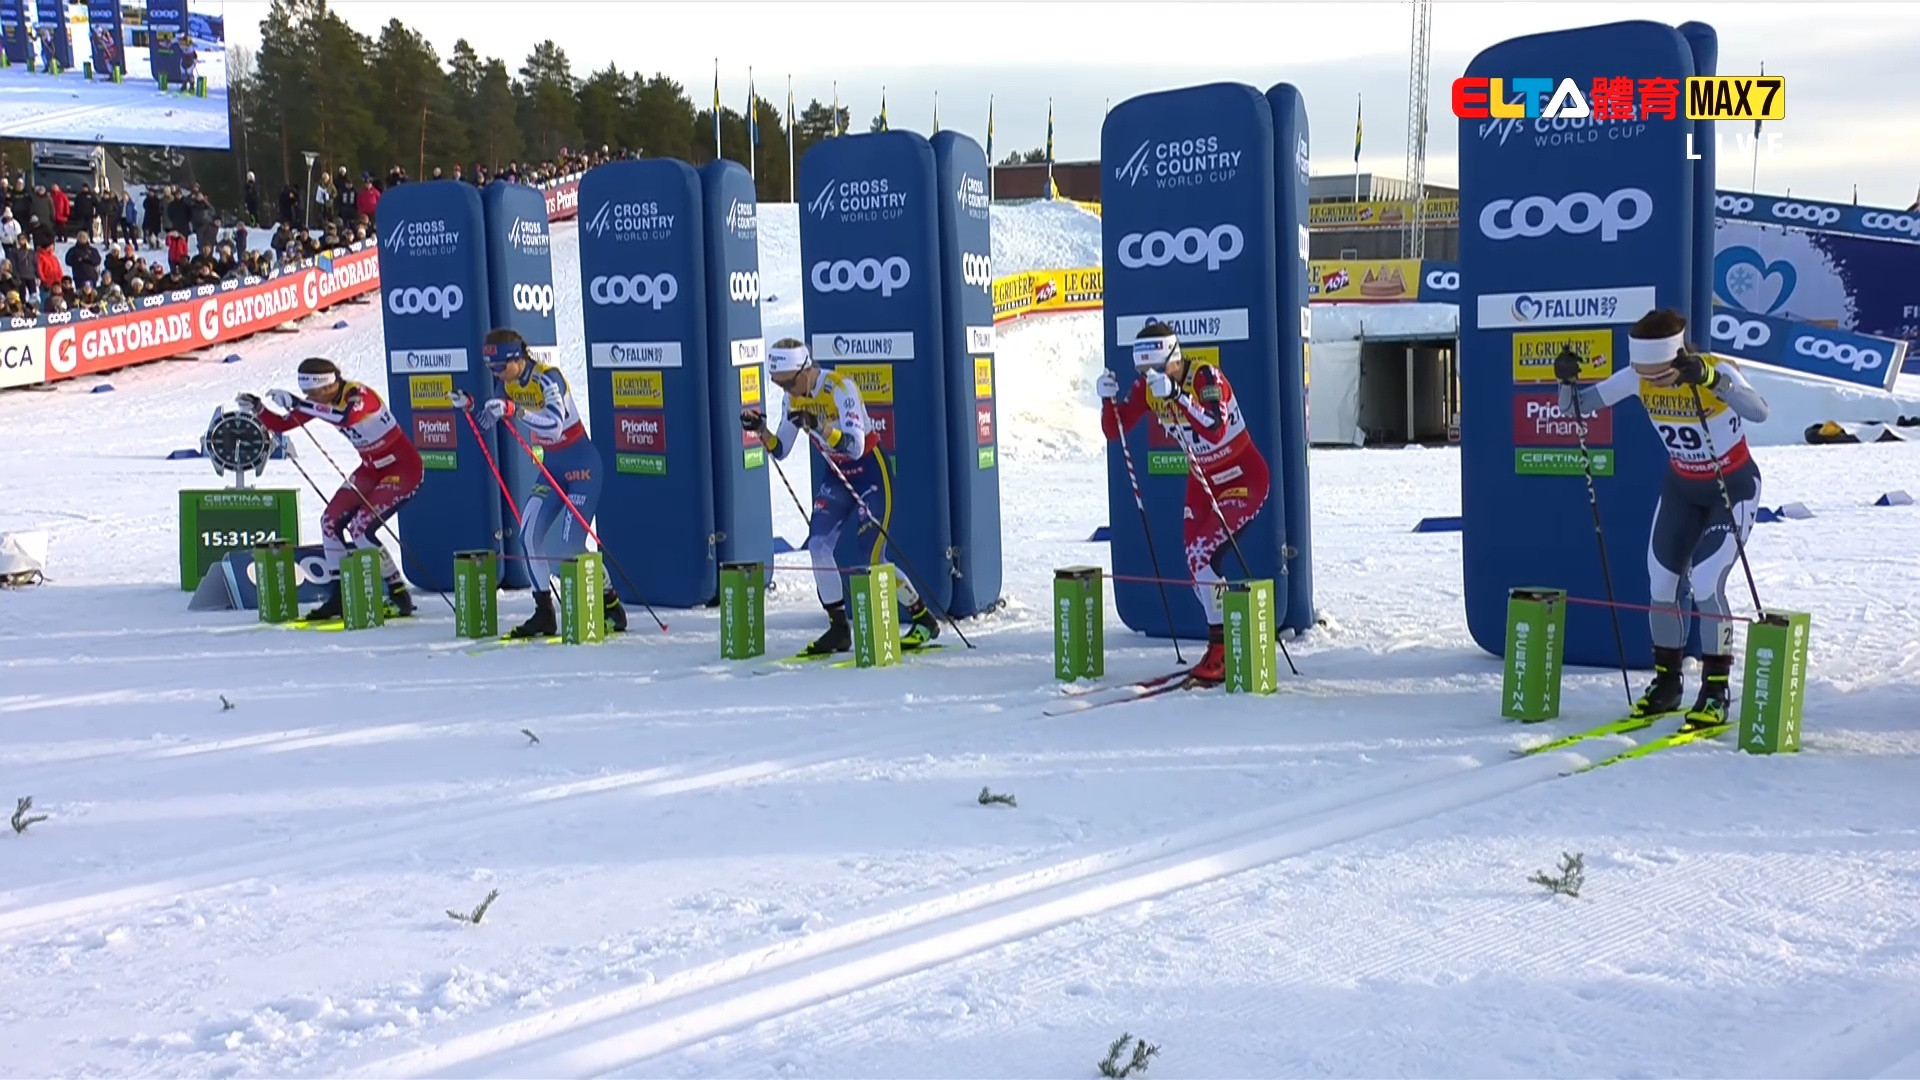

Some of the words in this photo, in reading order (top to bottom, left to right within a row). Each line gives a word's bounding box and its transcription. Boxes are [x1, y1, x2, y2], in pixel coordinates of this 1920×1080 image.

[150, 9, 179, 19] coop
[1535, 128, 1598, 148] WORLD
[1608, 123, 1647, 141] CUP
[1156, 136, 1219, 160] CROSS
[1156, 150, 1242, 177] COUNTRY
[840, 178, 889, 197] CROSS
[1156, 172, 1203, 189] WORLD
[1209, 169, 1237, 183] CUP
[614, 202, 658, 218] CROSS
[840, 193, 907, 212] COUNTRY
[1310, 207, 1319, 217] LE
[1321, 204, 1357, 217] GRUYÈRE
[614, 215, 675, 232] COUNTRY
[840, 212, 878, 224] WORLD
[882, 209, 903, 220] CUP
[1479, 188, 1653, 242] coop
[1772, 202, 1840, 226] coop
[408, 219, 445, 234] CROSS
[520, 221, 542, 234] CROSS
[615, 231, 648, 242] WORLD
[652, 229, 672, 240] CUP
[408, 231, 460, 247] COUNTRY
[521, 233, 549, 247] COUNTRY
[1118, 224, 1244, 271] coop
[319, 254, 380, 297] GATORADE
[811, 256, 911, 297] coop
[962, 252, 992, 294] coop
[1064, 273, 1078, 292] LE
[197, 284, 215, 296] coop
[221, 278, 239, 291] coop
[590, 273, 678, 310] coop
[730, 271, 760, 308] coop
[999, 274, 1035, 302] GRUYÈRE
[143, 294, 164, 306] coop
[171, 289, 192, 301] coop
[389, 284, 464, 319] coop
[513, 283, 554, 317] coop
[222, 283, 299, 329] GATORADE
[1545, 297, 1600, 318] FALUN
[48, 311, 72, 324] coop
[82, 311, 192, 360] GATORADE
[1710, 314, 1771, 350] op
[626, 348, 654, 363] FALUN
[851, 338, 882, 354] FALUN
[1519, 343, 1532, 357] LE
[1794, 335, 1882, 372] coop
[0, 345, 33, 369] CA
[420, 354, 444, 368] FALUN
[853, 370, 882, 386] RUYÈRE
[418, 420, 451, 433] Prioritet
[621, 419, 659, 434] Prioritet
[626, 432, 654, 446] Finans
[1658, 425, 1702, 450] 29
[619, 458, 655, 466] CERTINA
[1152, 455, 1188, 464] CERTI
[204, 494, 261, 502] CERTINA
[202, 530, 277, 546] 15:31:24
[585, 575, 598, 640] CERTINA
[879, 590, 894, 661] CERTINA
[1060, 613, 1071, 675] CERTINA
[1256, 610, 1270, 692] CERTINA
[1231, 628, 1245, 693] CERTINA
[1511, 640, 1528, 712] CERTINA
[1542, 640, 1554, 712] CERTINA
[1749, 668, 1770, 746] CERTINA
[1784, 648, 1802, 747] CERTINA
